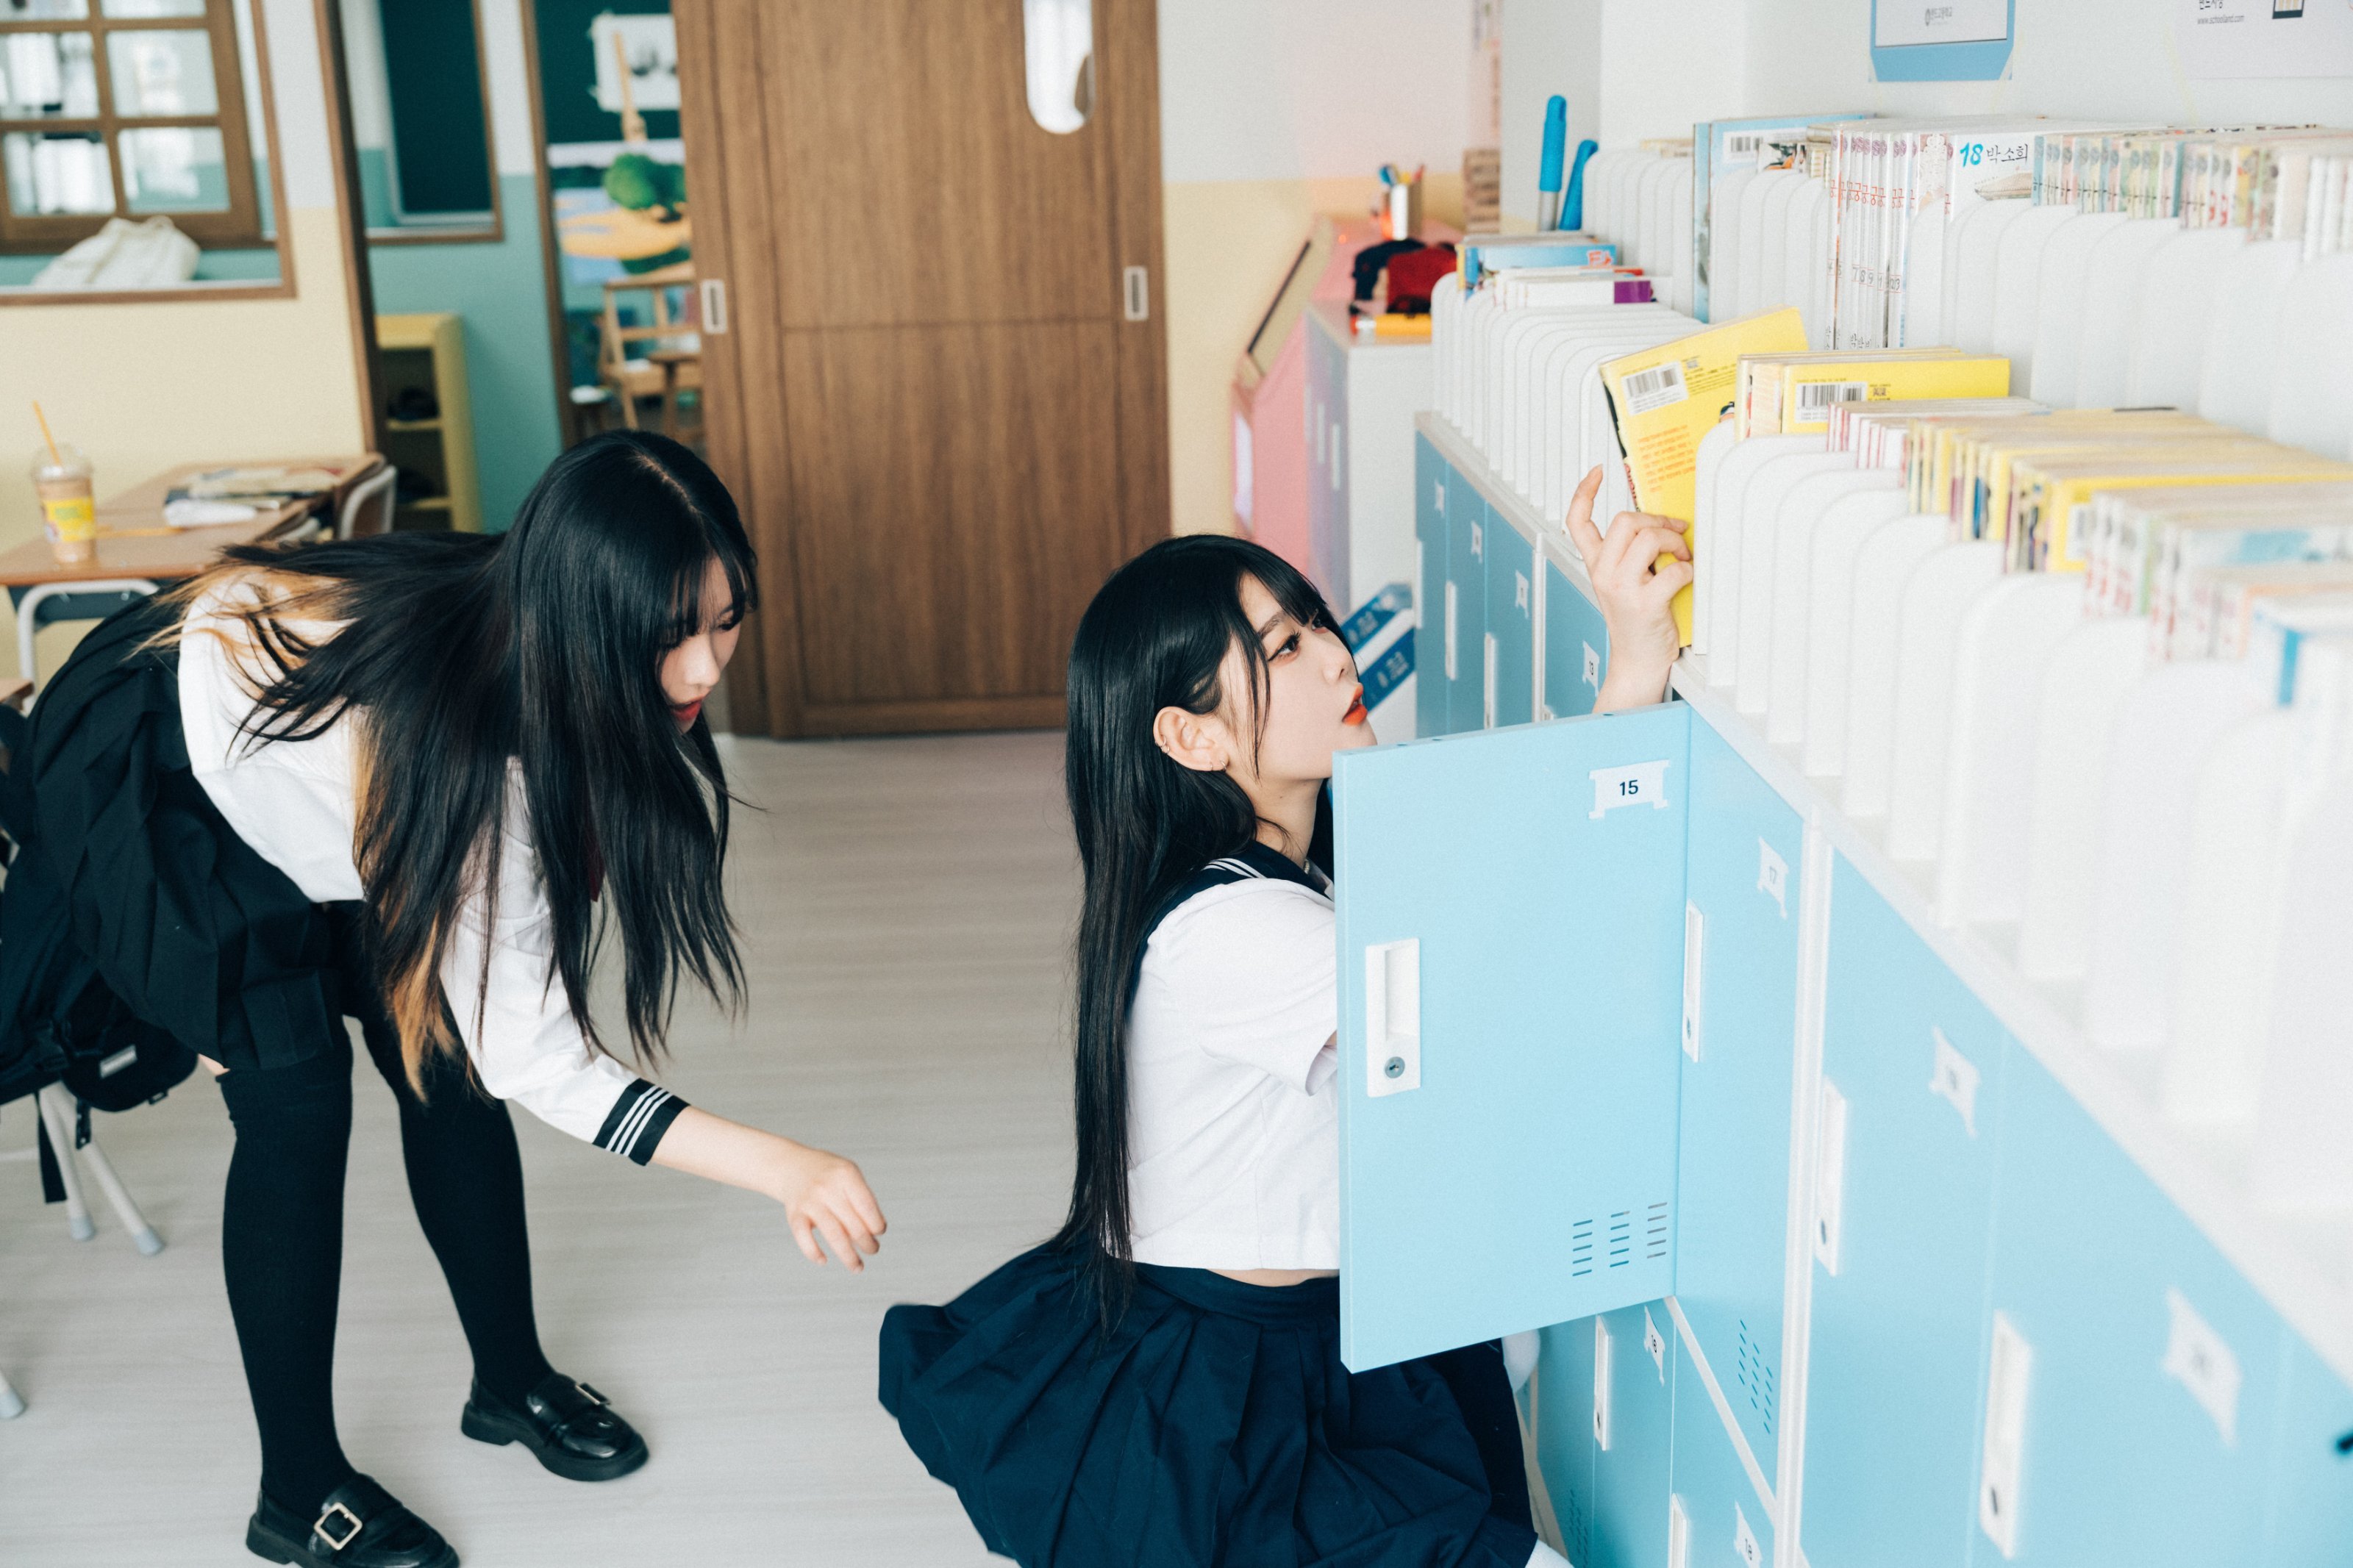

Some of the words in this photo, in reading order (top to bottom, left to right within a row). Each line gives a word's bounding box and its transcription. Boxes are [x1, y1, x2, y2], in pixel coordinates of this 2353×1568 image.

[1960, 142, 1984, 168] 18
[1860, 270, 1866, 283] 8
[1868, 272, 1874, 284] 9
[1619, 779, 1639, 796] 15
